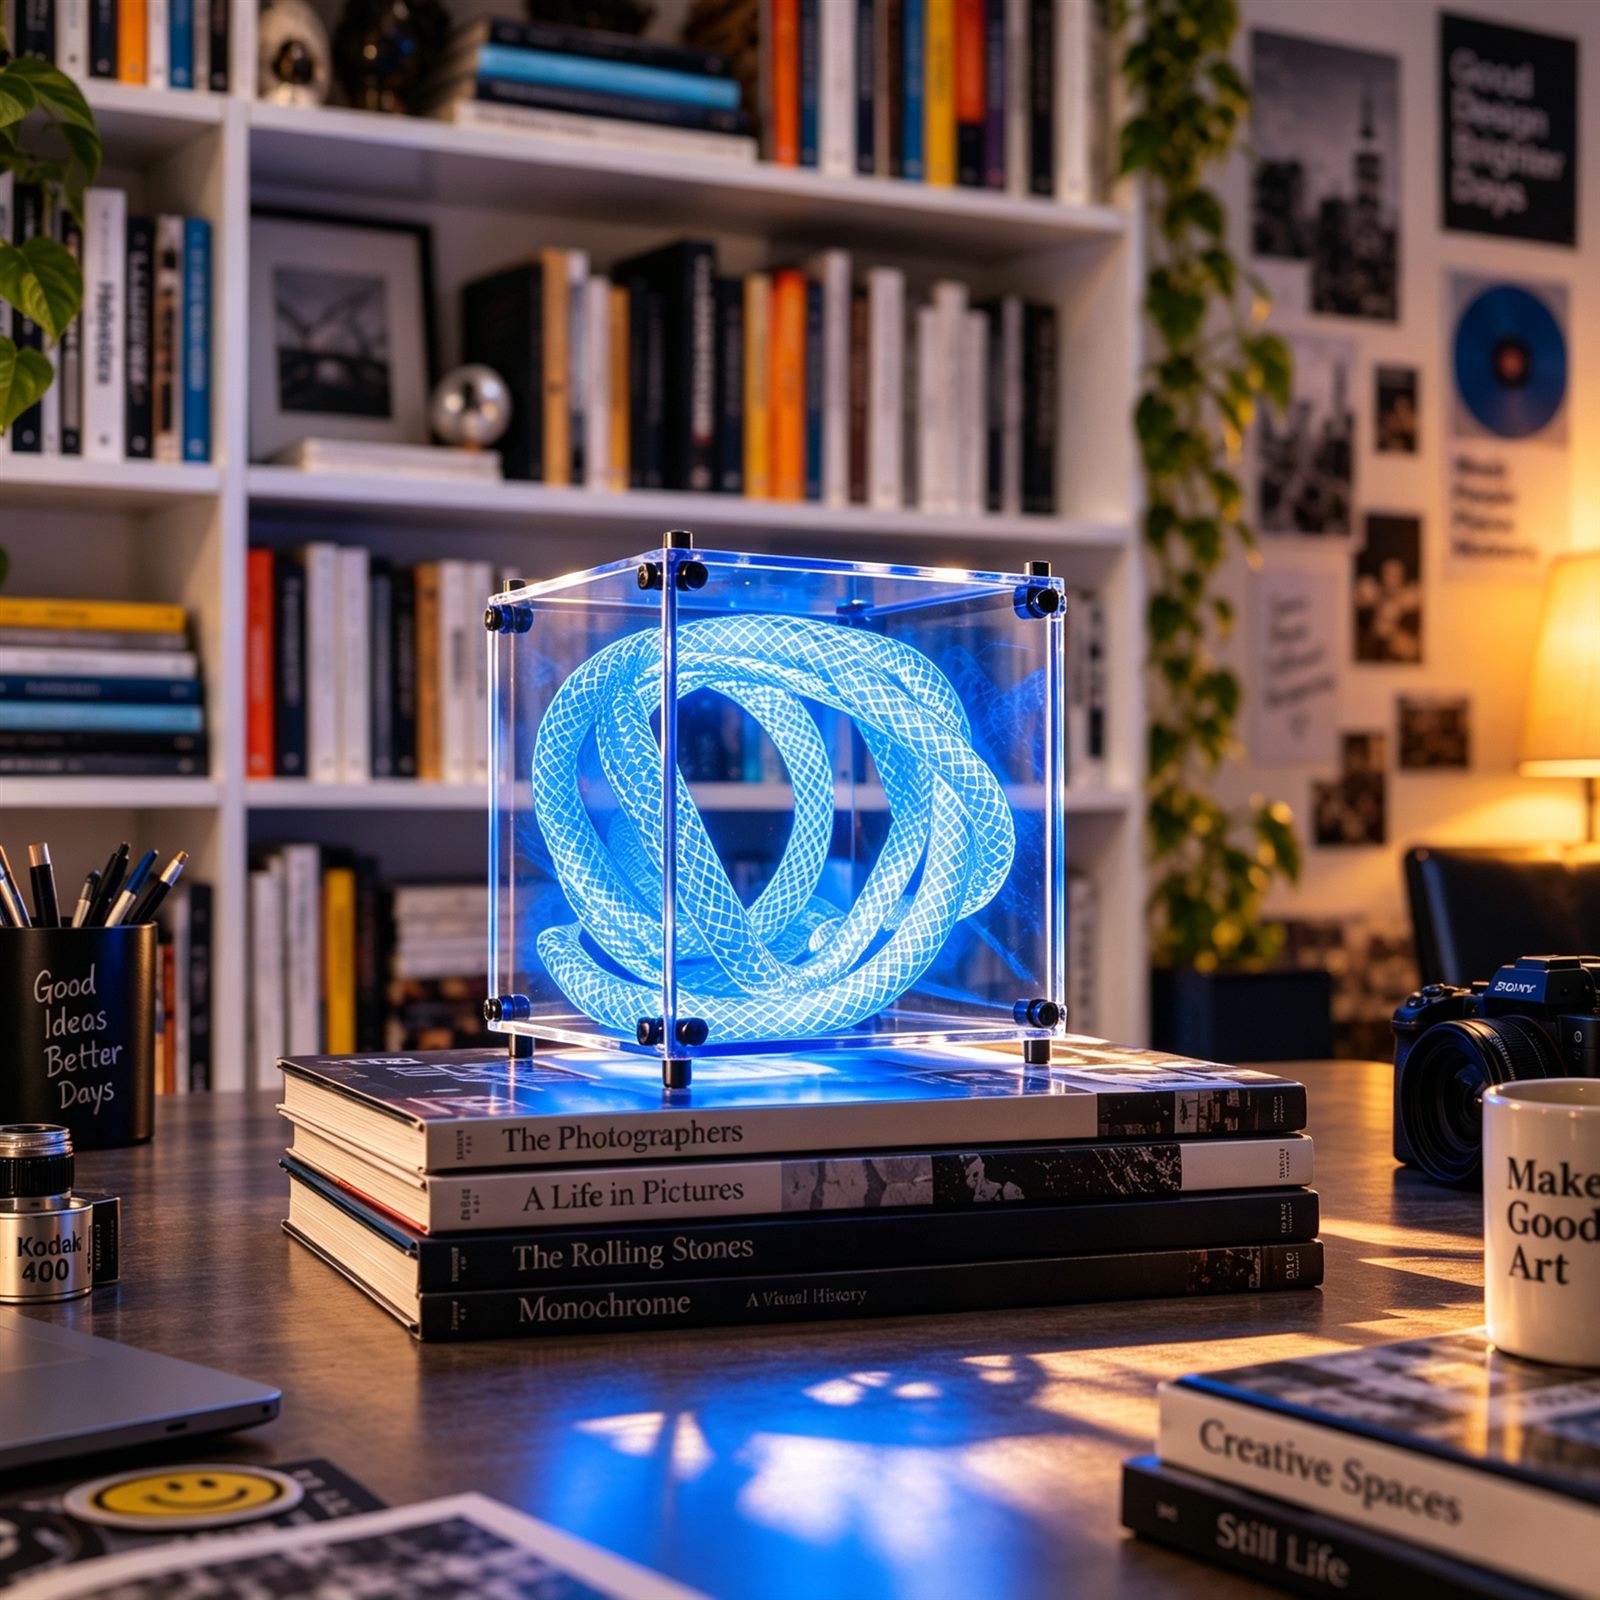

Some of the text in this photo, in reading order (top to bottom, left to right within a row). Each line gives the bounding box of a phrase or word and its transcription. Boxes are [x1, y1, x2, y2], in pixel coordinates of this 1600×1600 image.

[1451, 48, 1534, 97] Good
[34, 963, 97, 1004] Good
[1494, 981, 1536, 994] SONY
[45, 1006, 107, 1039] Ideas
[44, 1040, 123, 1078] Better
[58, 1080, 115, 1115] Days
[502, 1127, 550, 1152] The
[558, 1119, 743, 1153] Photographers
[522, 1178, 744, 1211] A Life in Pictures
[1507, 1156, 1600, 1199] Make
[1507, 1200, 1600, 1244] Good
[17, 1231, 82, 1257] Kodak
[512, 1236, 754, 1271] The Rolling Stones
[22, 1258, 69, 1283] 400
[1508, 1243, 1570, 1285] Art
[518, 1292, 691, 1323] Monochrome
[745, 1292, 759, 1308] A
[1199, 1418, 1464, 1526] Creative Spaces
[1216, 1512, 1351, 1589] Still Life
